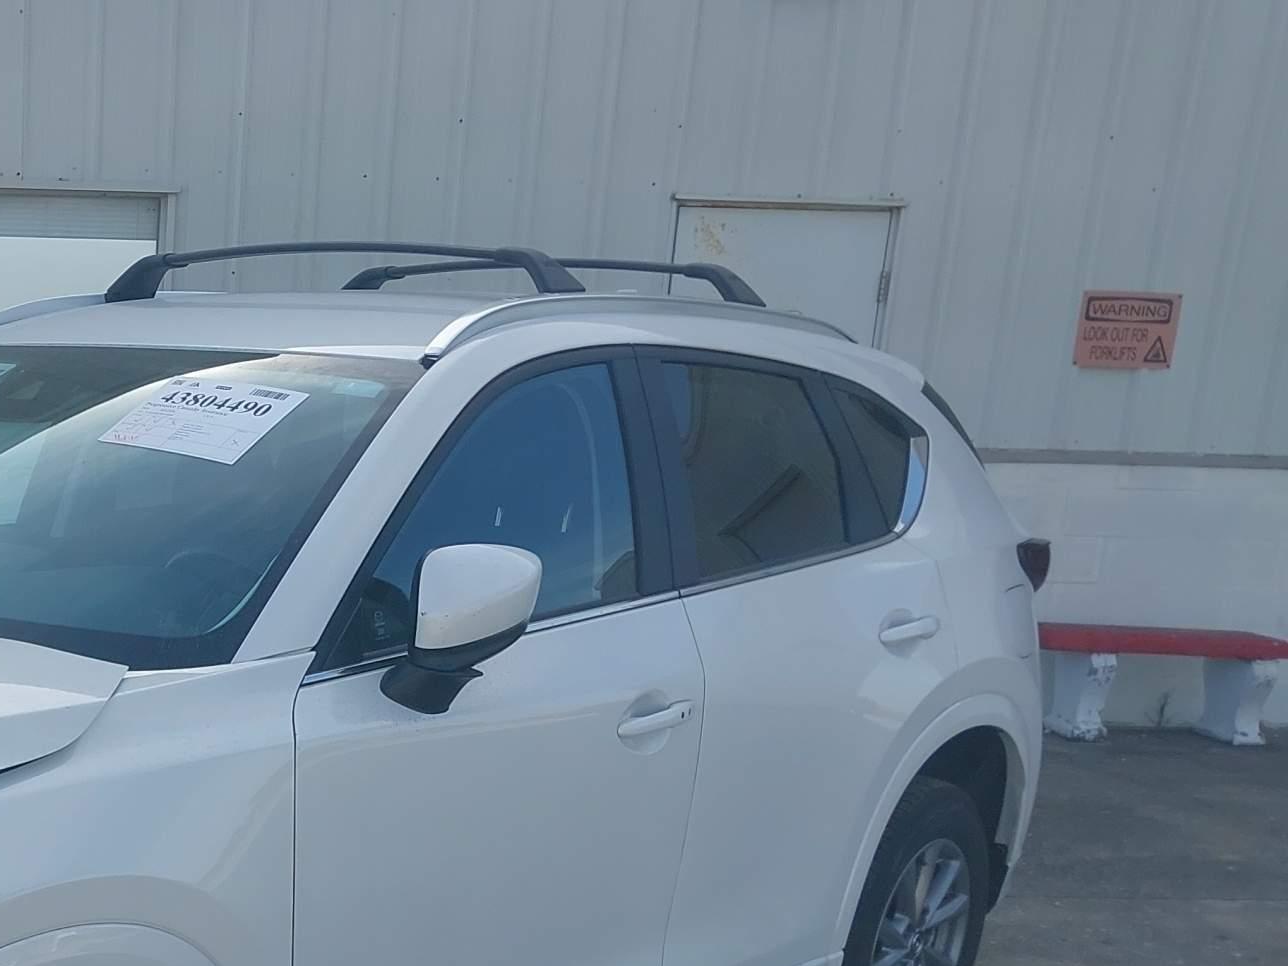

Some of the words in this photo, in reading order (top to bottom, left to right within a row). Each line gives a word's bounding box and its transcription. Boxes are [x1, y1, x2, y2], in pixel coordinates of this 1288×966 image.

[1093, 304, 1168, 317] WARNING
[1083, 326, 1111, 341] LOOK
[1112, 327, 1130, 342] OUT
[1132, 328, 1149, 342] FOR
[1088, 345, 1137, 361] FORKLIFTS
[161, 391, 272, 416] 43804490
